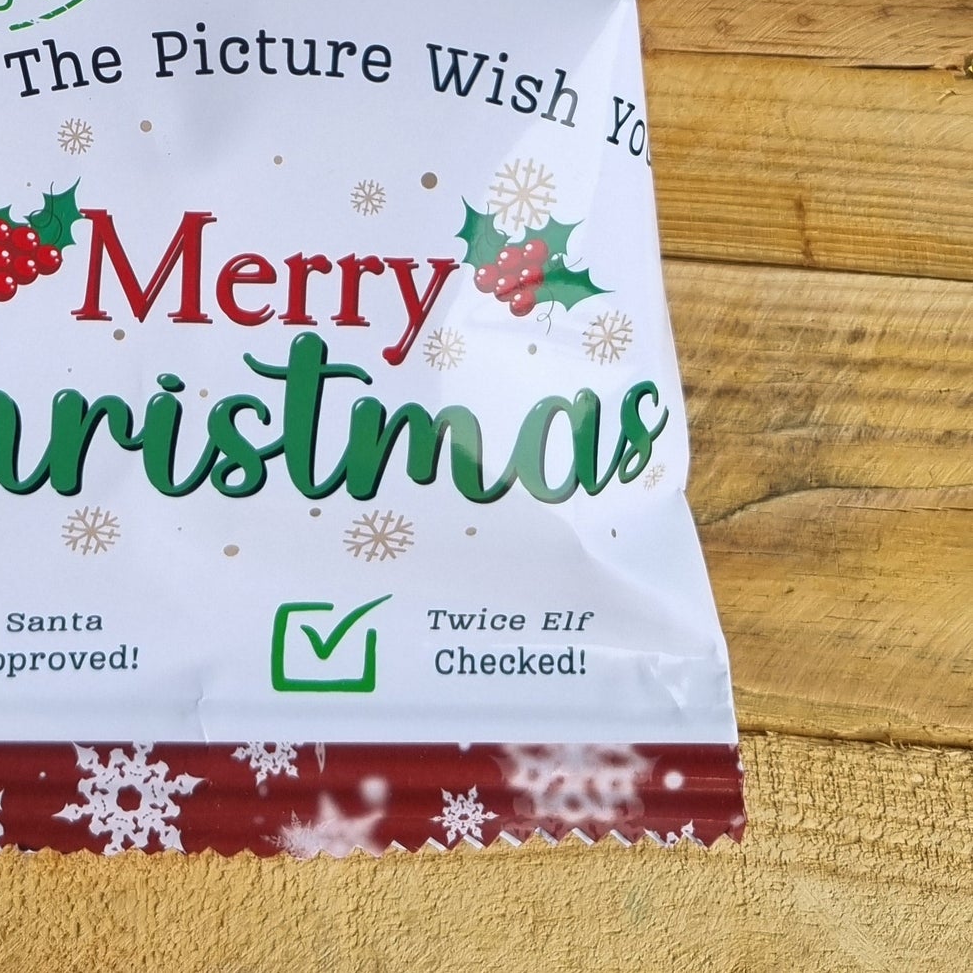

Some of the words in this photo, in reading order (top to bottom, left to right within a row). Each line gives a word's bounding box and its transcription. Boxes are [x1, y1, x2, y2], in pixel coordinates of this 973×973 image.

[4, 38, 124, 98] The
[151, 22, 393, 83] Picture
[426, 44, 580, 128] Wish
[606, 95, 652, 167] Yo
[71, 208, 459, 367] Merry
[5, 612, 104, 635] Santa
[426, 609, 527, 633] Twice
[541, 610, 596, 633] Elf
[434, 646, 588, 677] Checked!
